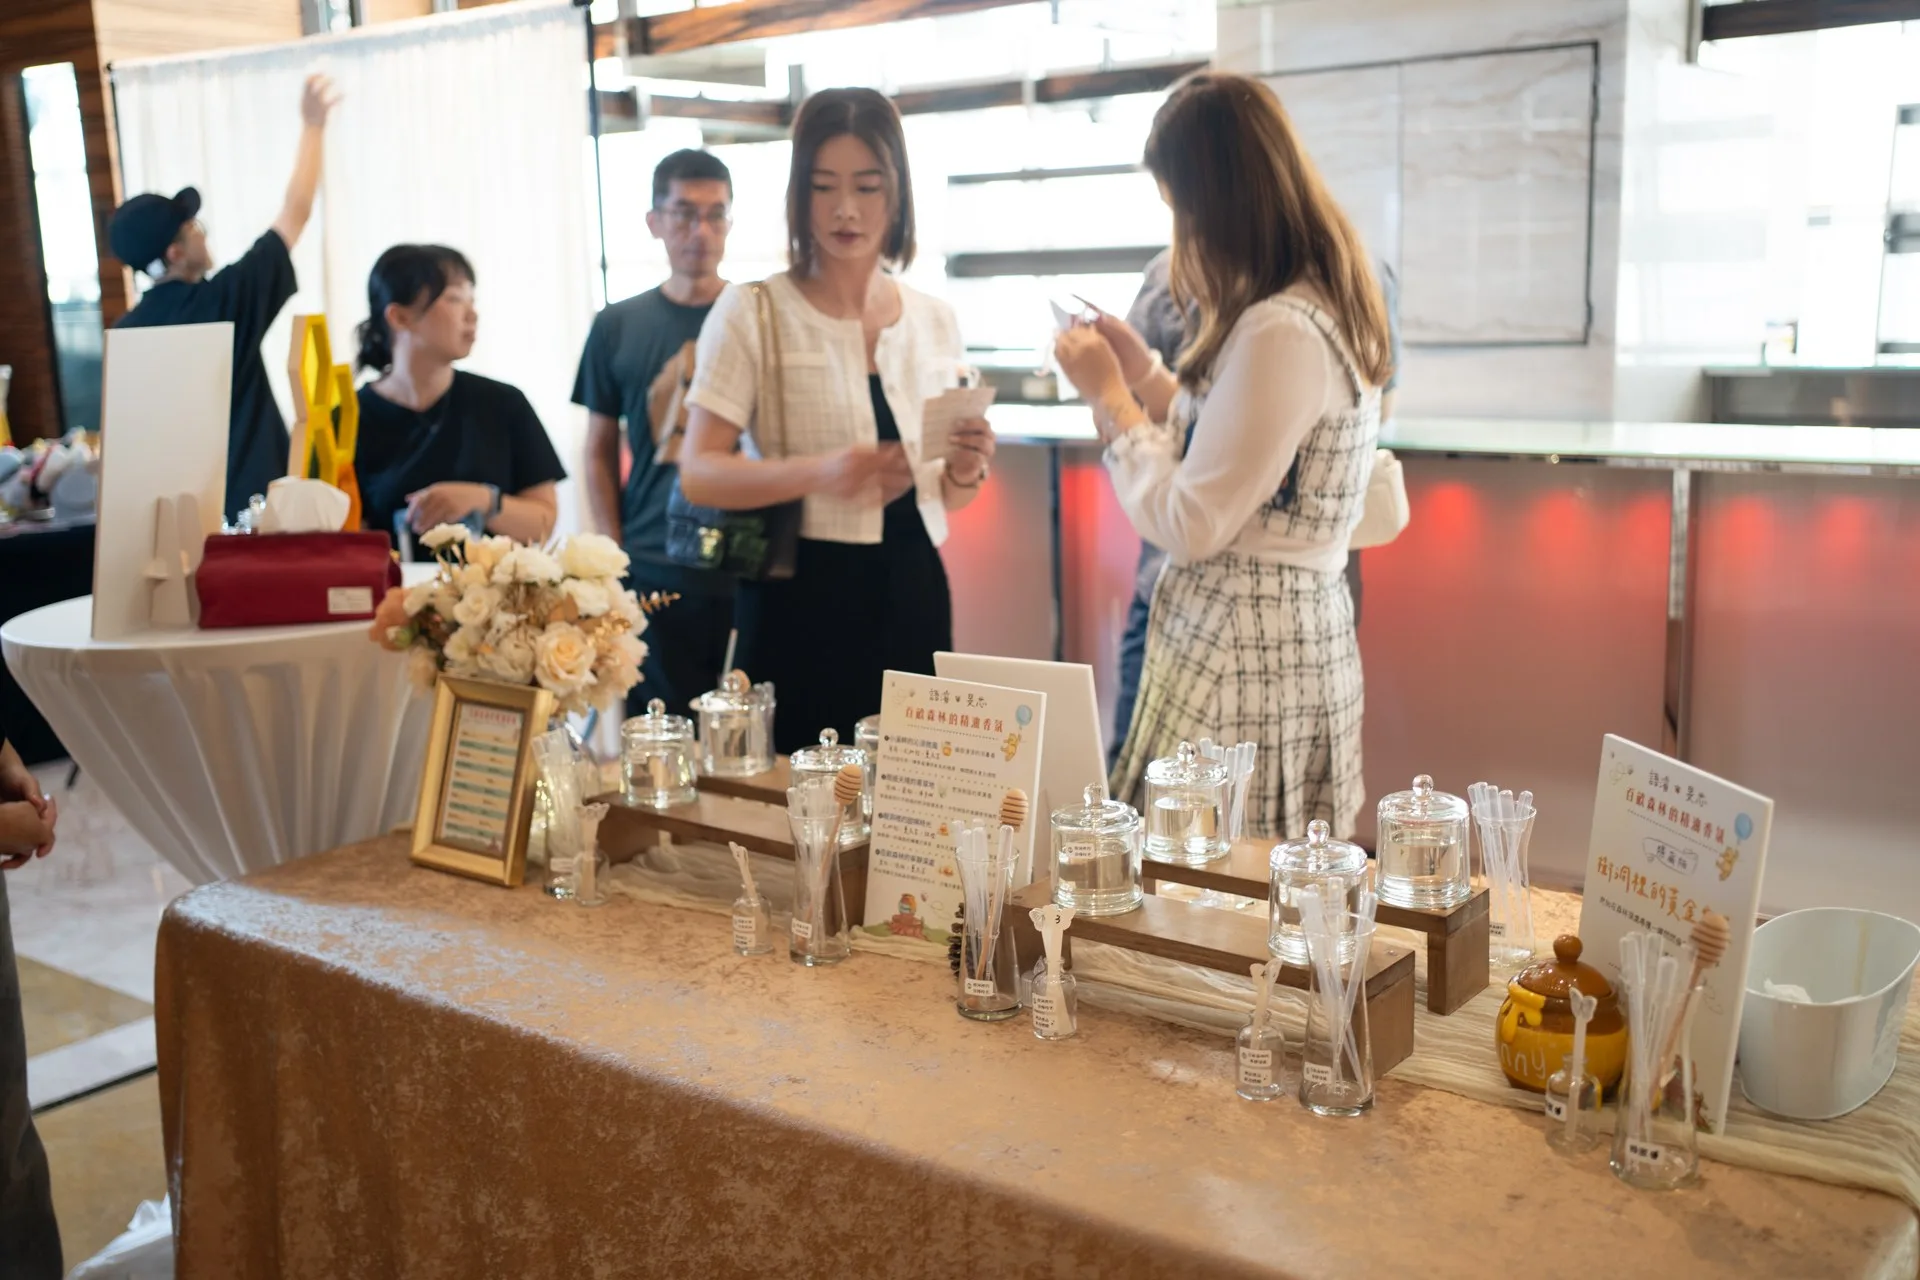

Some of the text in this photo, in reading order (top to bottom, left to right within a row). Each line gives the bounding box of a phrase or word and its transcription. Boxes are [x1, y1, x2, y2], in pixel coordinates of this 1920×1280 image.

[1597, 856, 1731, 924] 樹洞裡的黃金
[1054, 914, 1061, 924] 3
